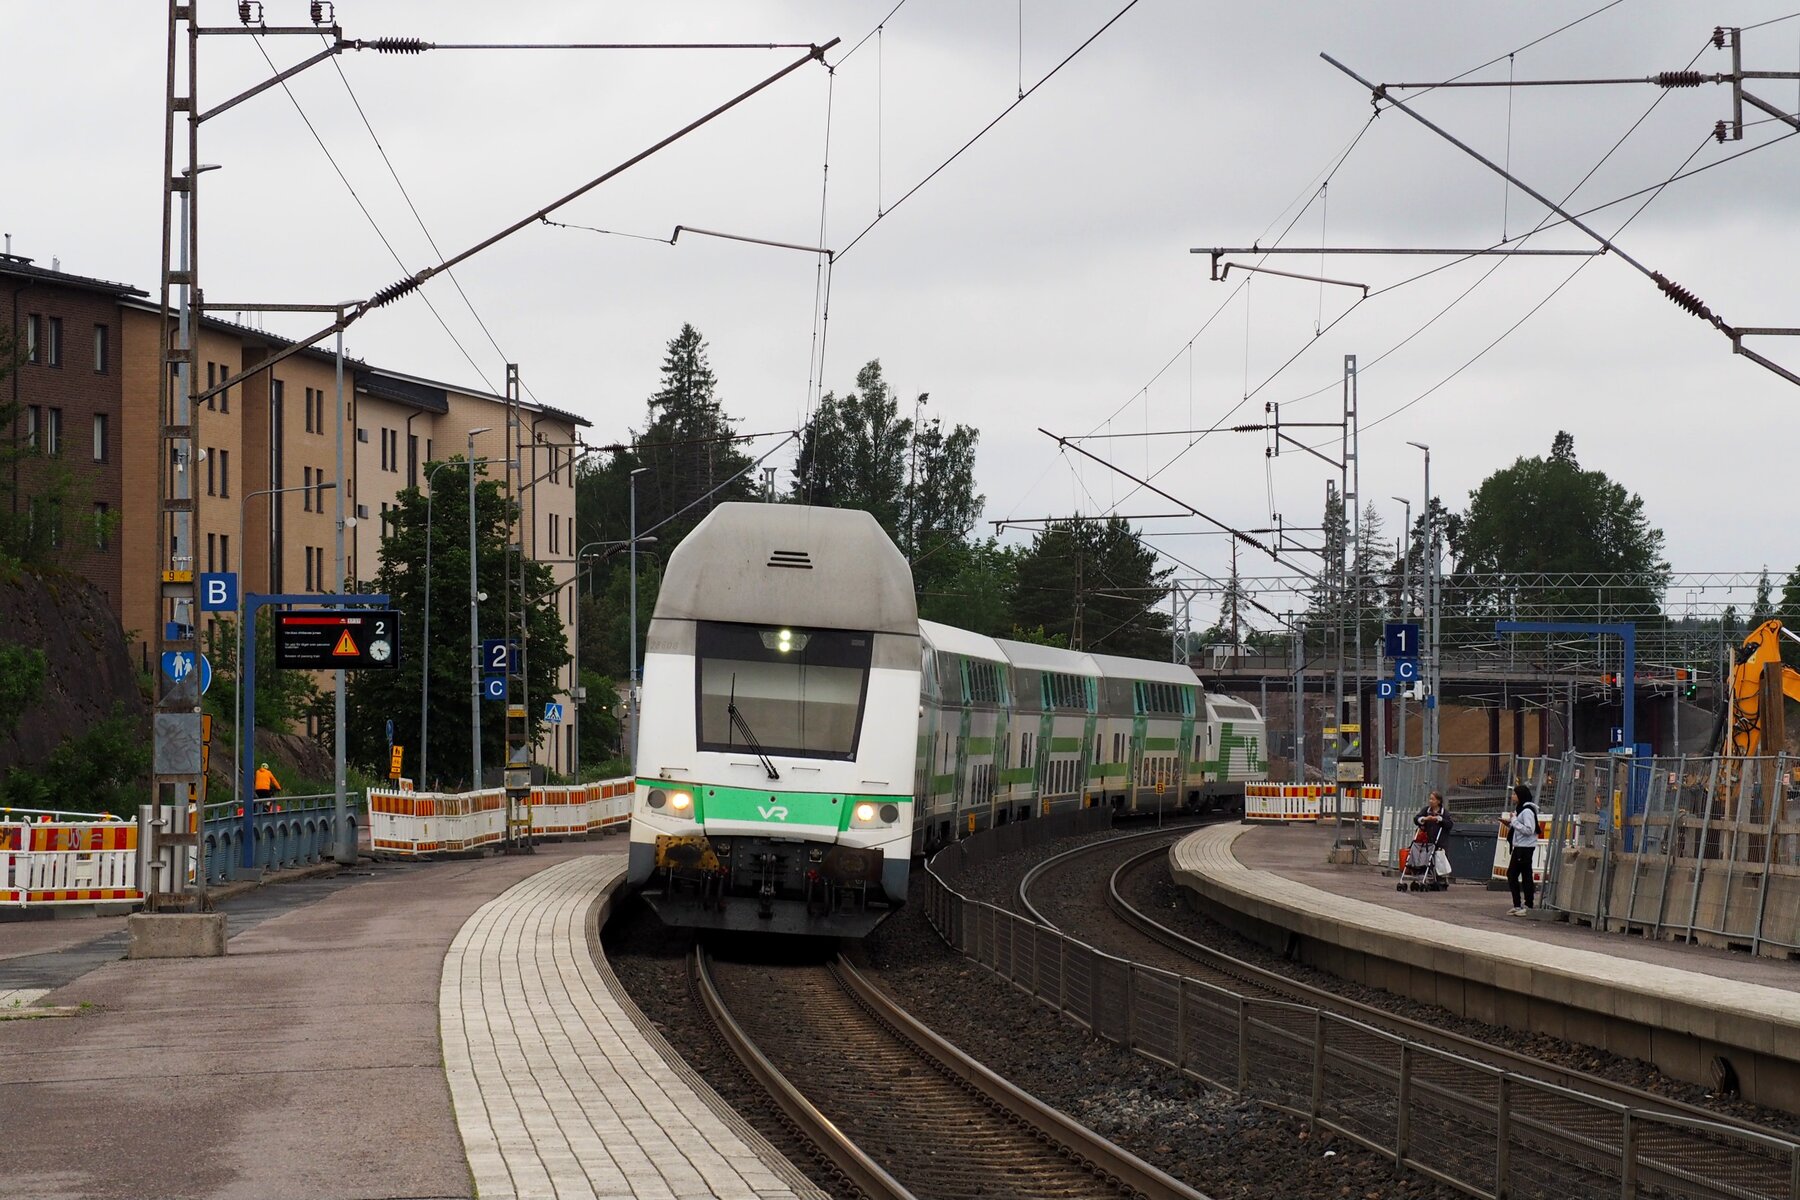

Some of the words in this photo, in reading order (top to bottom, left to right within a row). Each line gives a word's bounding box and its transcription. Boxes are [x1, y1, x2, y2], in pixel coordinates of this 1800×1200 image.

[208, 580, 227, 604] B
[375, 620, 385, 635] 2
[1396, 629, 1406, 652] 1
[492, 645, 507, 668] 2
[1399, 662, 1413, 678] C
[490, 680, 503, 696] C
[1381, 683, 1392, 696] D
[757, 805, 789, 821] VR
